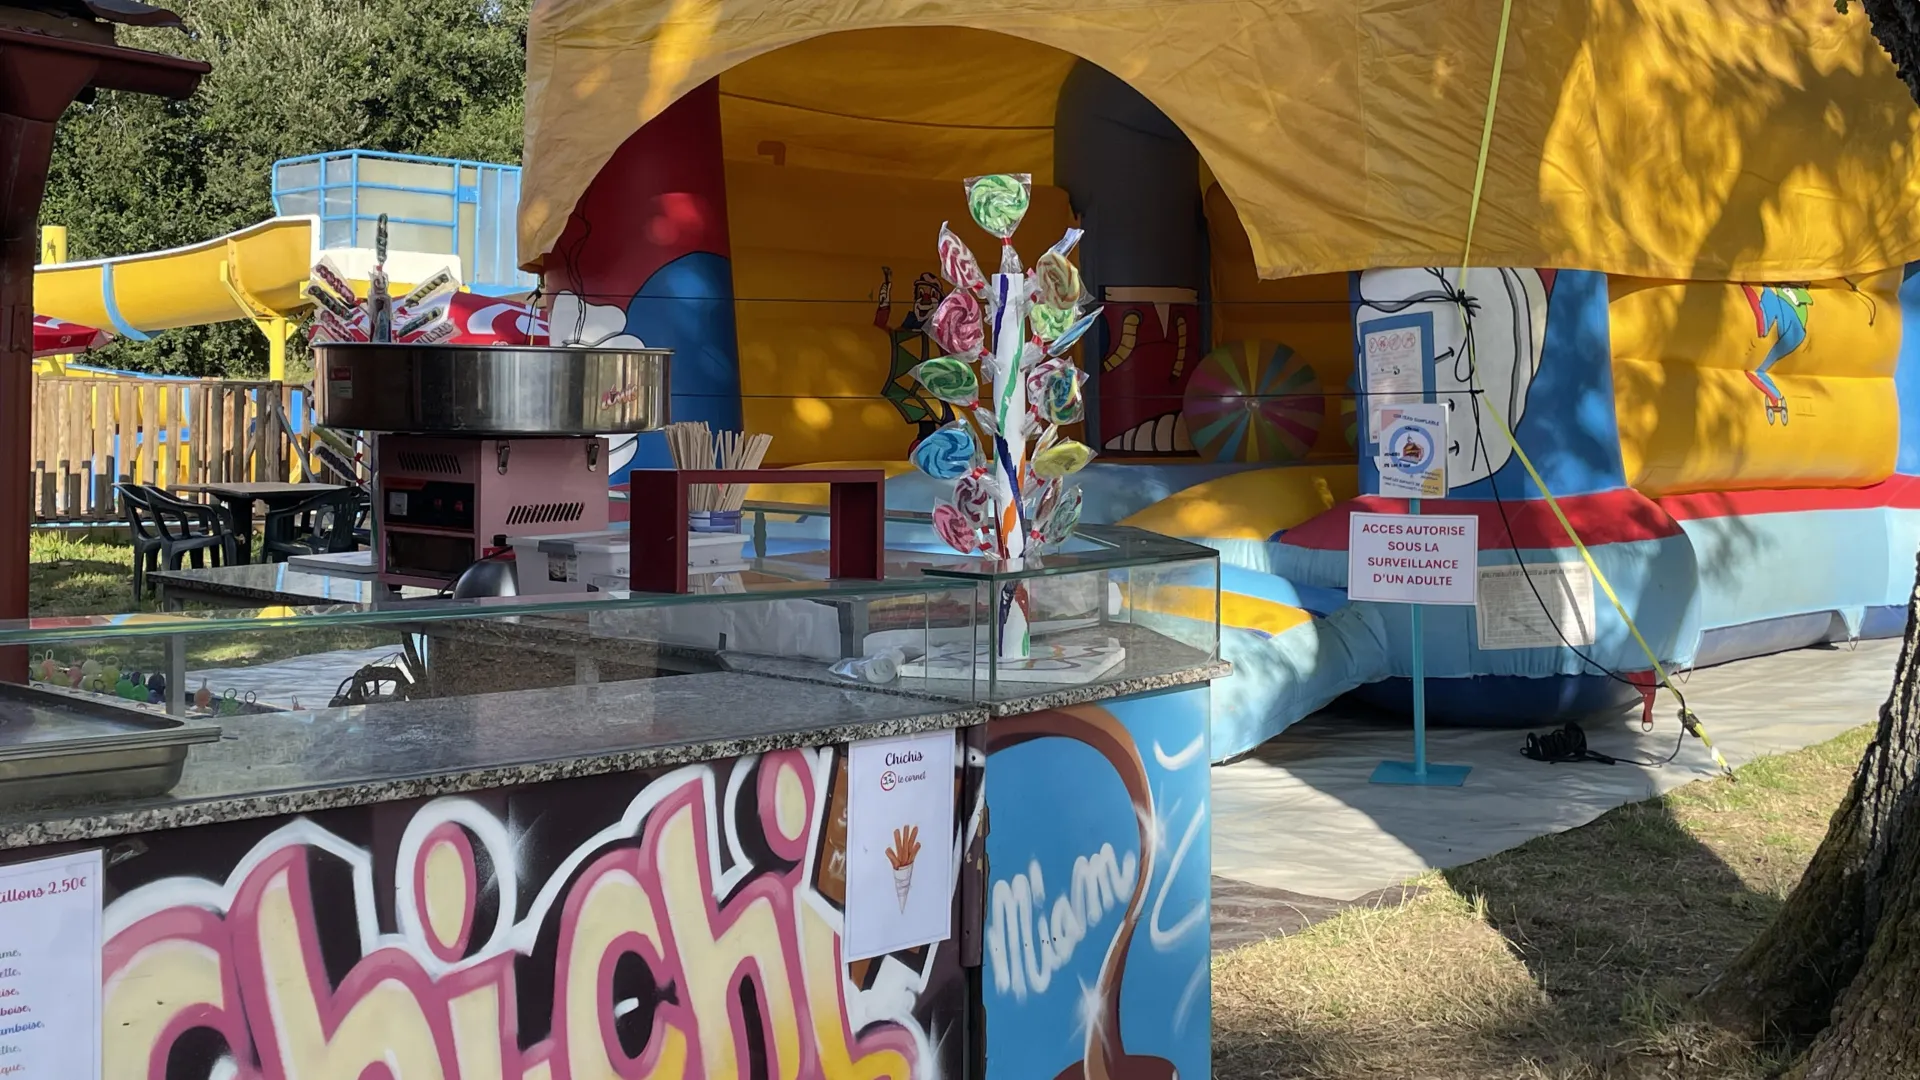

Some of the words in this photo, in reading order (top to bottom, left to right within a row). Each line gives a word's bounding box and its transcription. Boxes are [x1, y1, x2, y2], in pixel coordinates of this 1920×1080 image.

[1362, 523, 1403, 535] ACCES
[1406, 525, 1465, 536] AUTORISE
[1388, 541, 1421, 552] SOUS
[1425, 543, 1439, 552] LA
[1368, 557, 1459, 569] SURVEILLANCE
[1373, 573, 1404, 584] D'UN
[1407, 575, 1452, 586] ADULTE
[885, 751, 924, 766] Chichis
[897, 776, 904, 784] le
[905, 771, 926, 782] cornet
[48, 876, 87, 895] 2.50€
[987, 842, 1137, 1003] Miam
